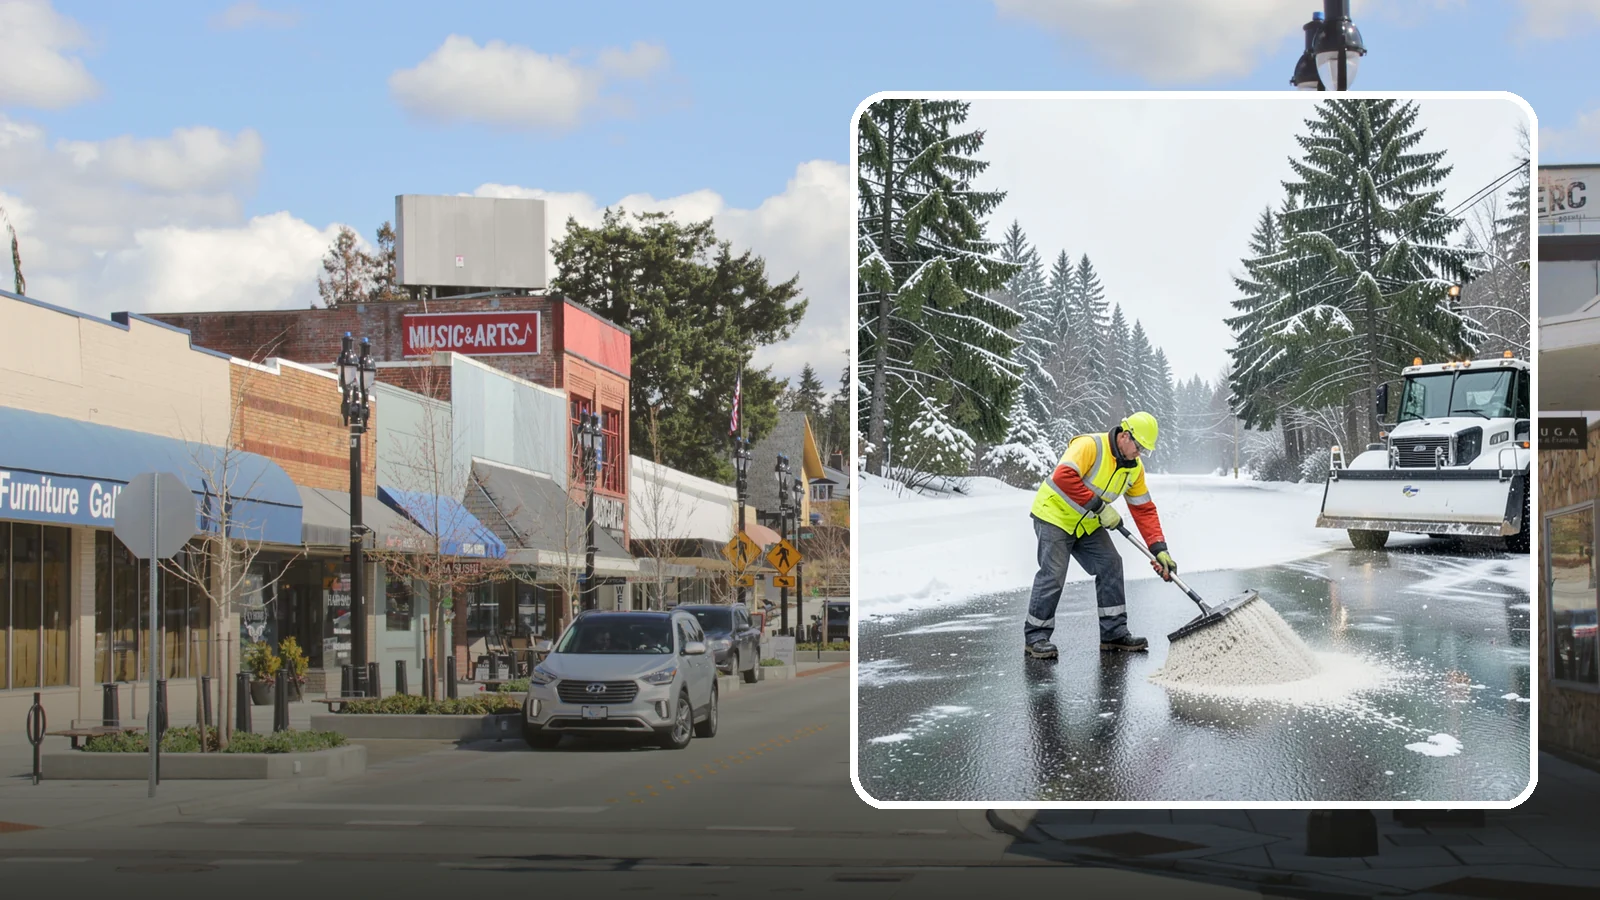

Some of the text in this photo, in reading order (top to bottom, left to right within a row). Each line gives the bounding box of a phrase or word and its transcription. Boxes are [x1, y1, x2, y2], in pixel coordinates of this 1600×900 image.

[0, 470, 122, 519] Furniture Gal
[453, 563, 479, 574] SUSHI
